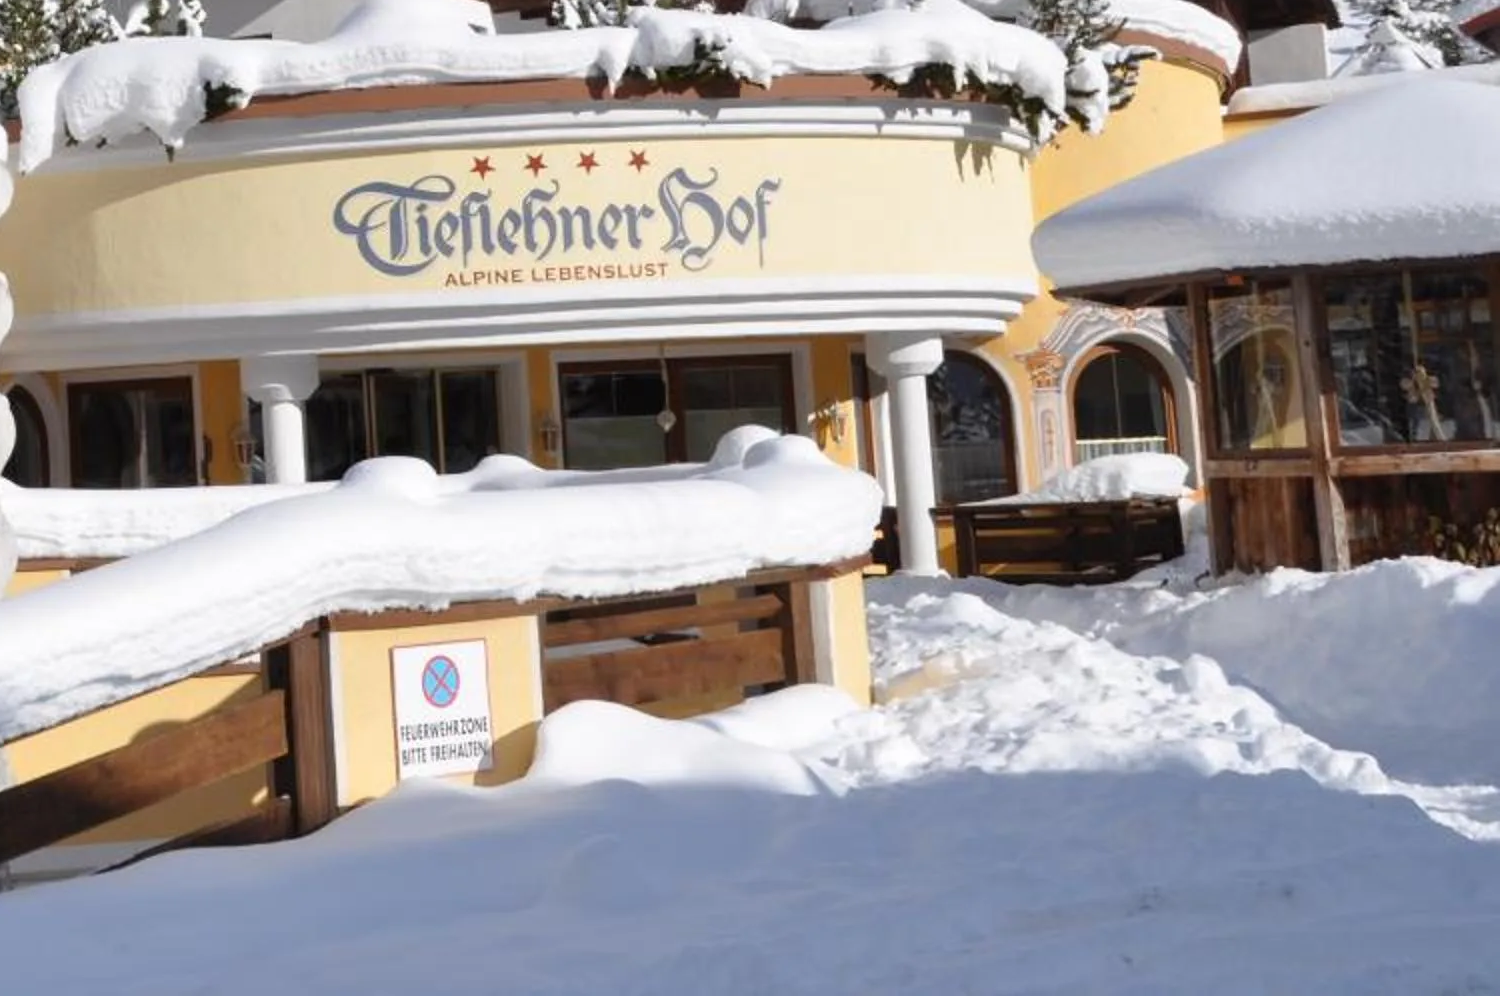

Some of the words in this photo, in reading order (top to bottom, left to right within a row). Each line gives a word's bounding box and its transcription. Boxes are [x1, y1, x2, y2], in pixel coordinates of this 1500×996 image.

[657, 167, 783, 271] Hof
[445, 269, 524, 288] ALPINE
[531, 262, 669, 282] LEBENSLUST
[400, 716, 488, 741] FEUERWEHRZONE
[402, 747, 427, 765] BITTE
